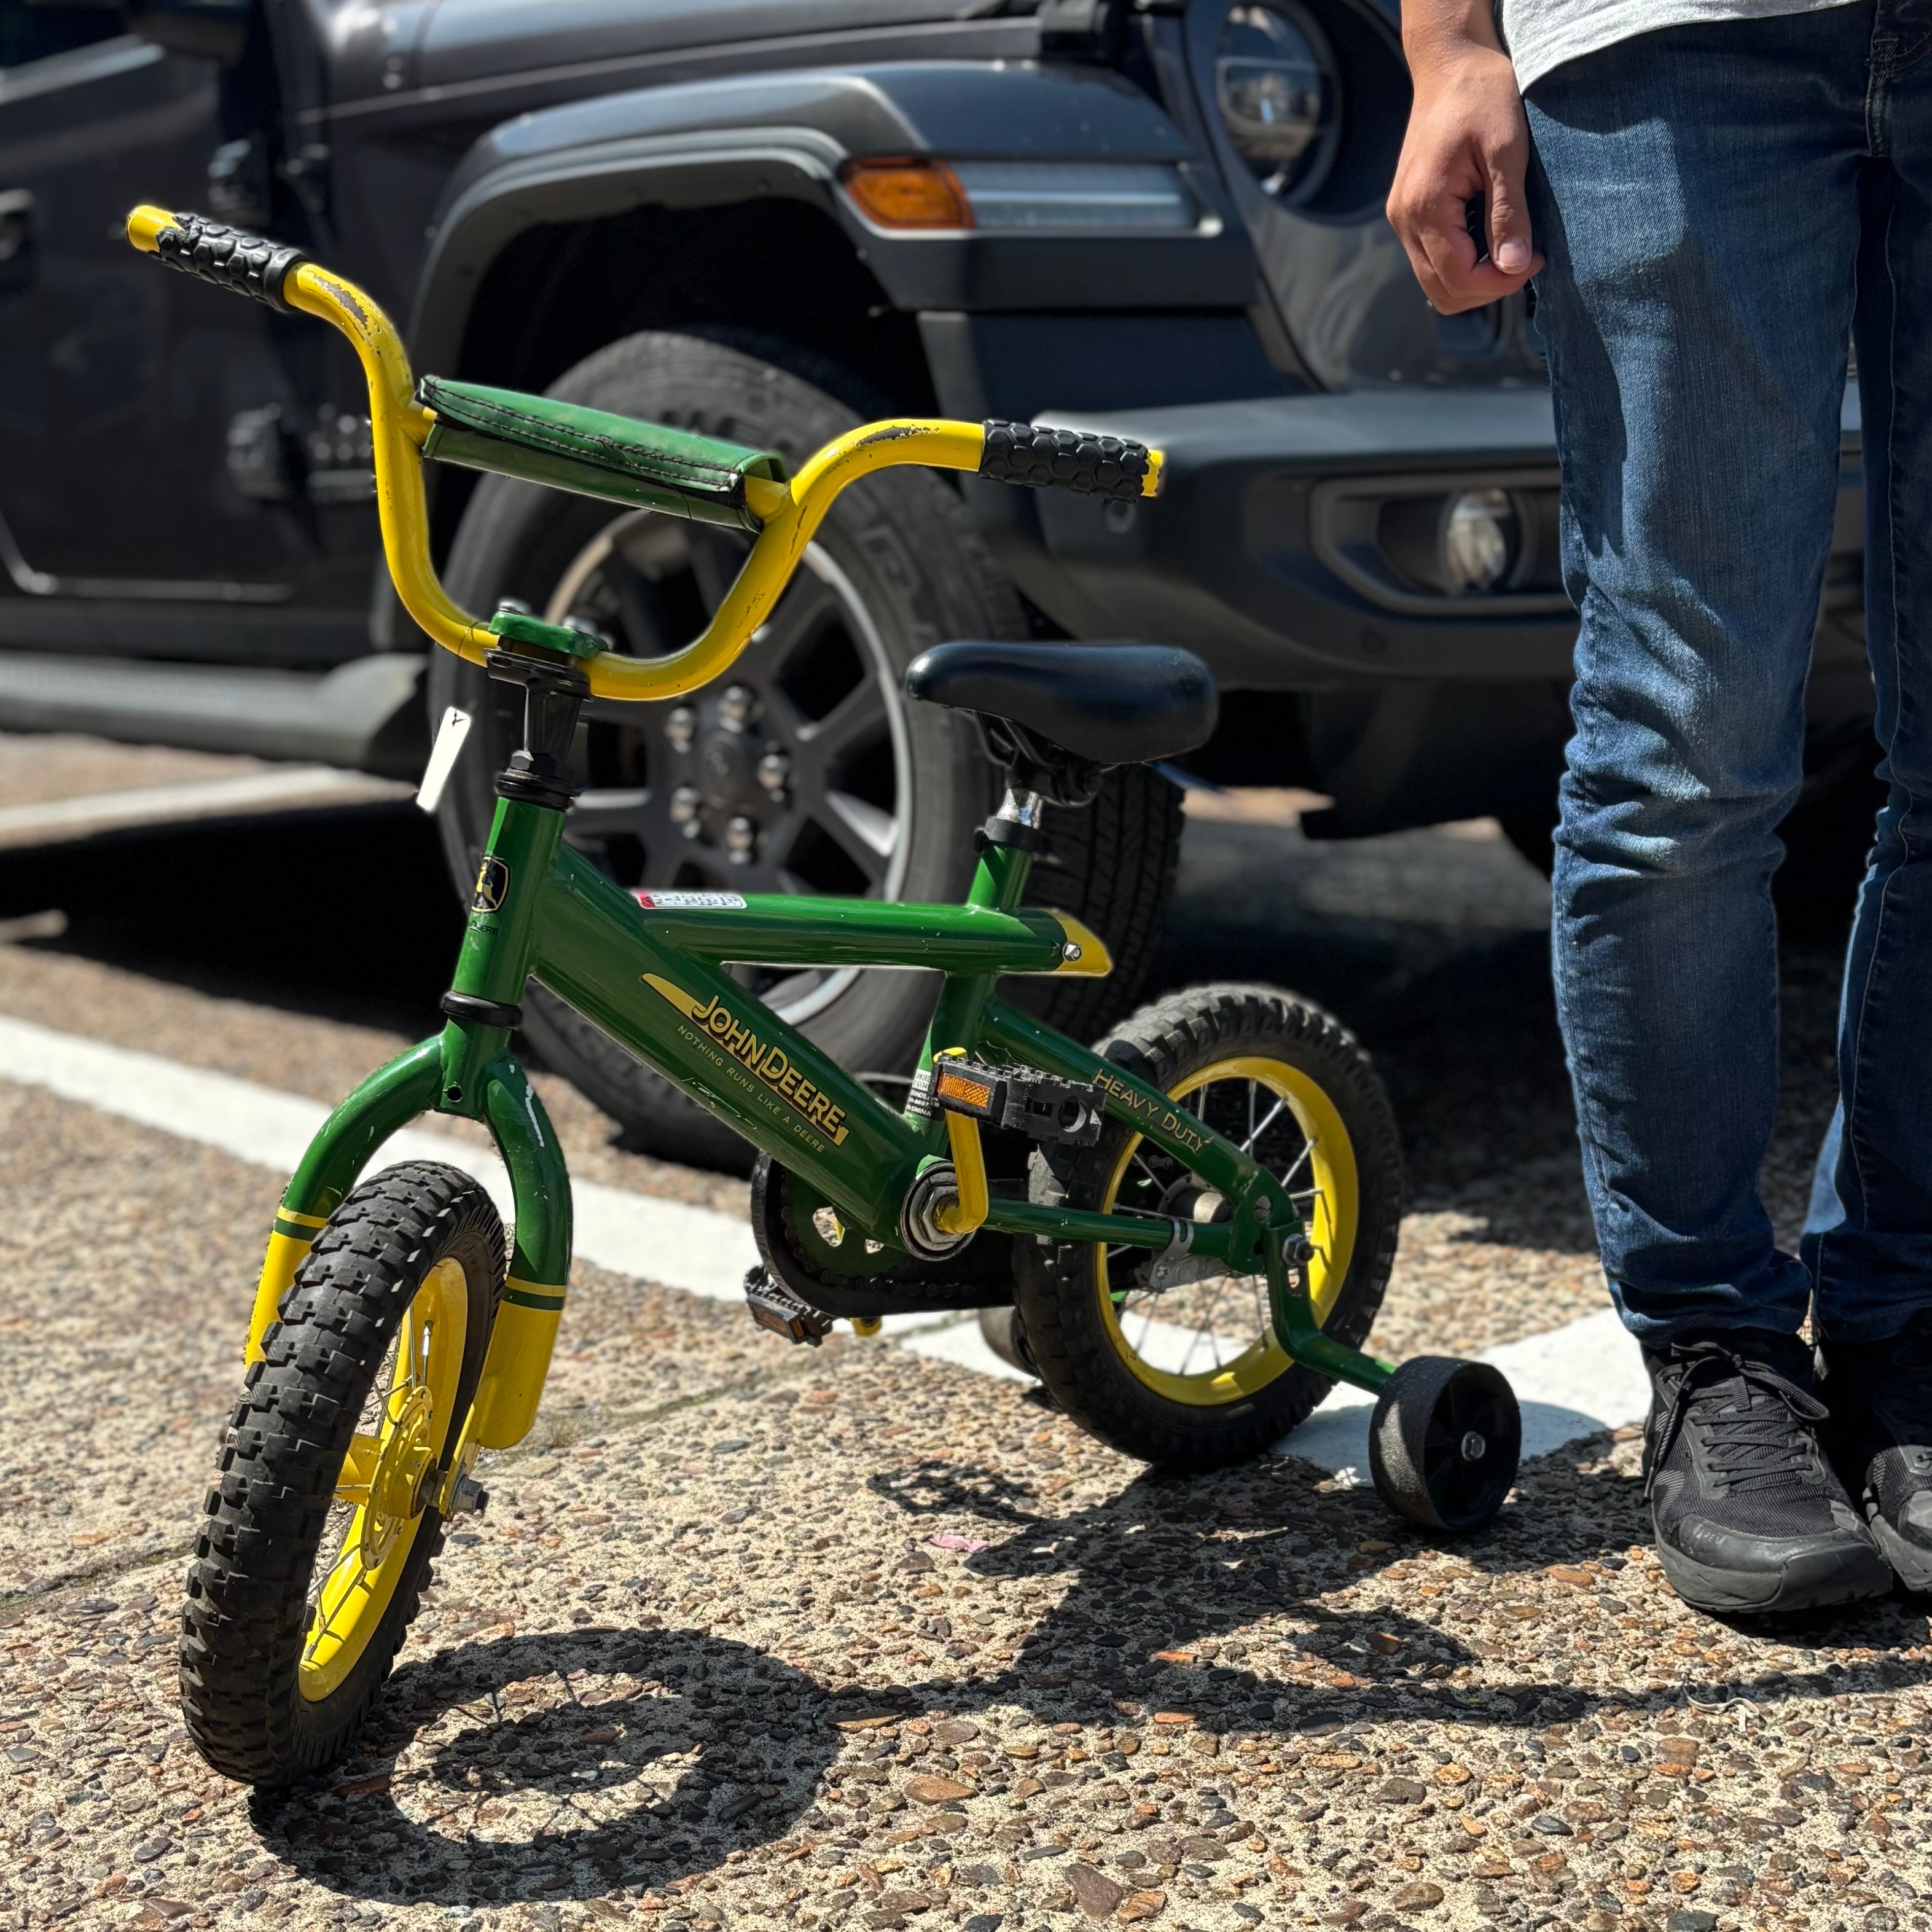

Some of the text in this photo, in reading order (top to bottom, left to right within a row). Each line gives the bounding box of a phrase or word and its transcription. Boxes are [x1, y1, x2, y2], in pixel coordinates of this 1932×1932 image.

[471, 920, 499, 935] ERE
[678, 1025, 825, 1153] NOTHING RUNS LIKE A DEERE
[1092, 1068, 1207, 1154] HEAVY DUTY
